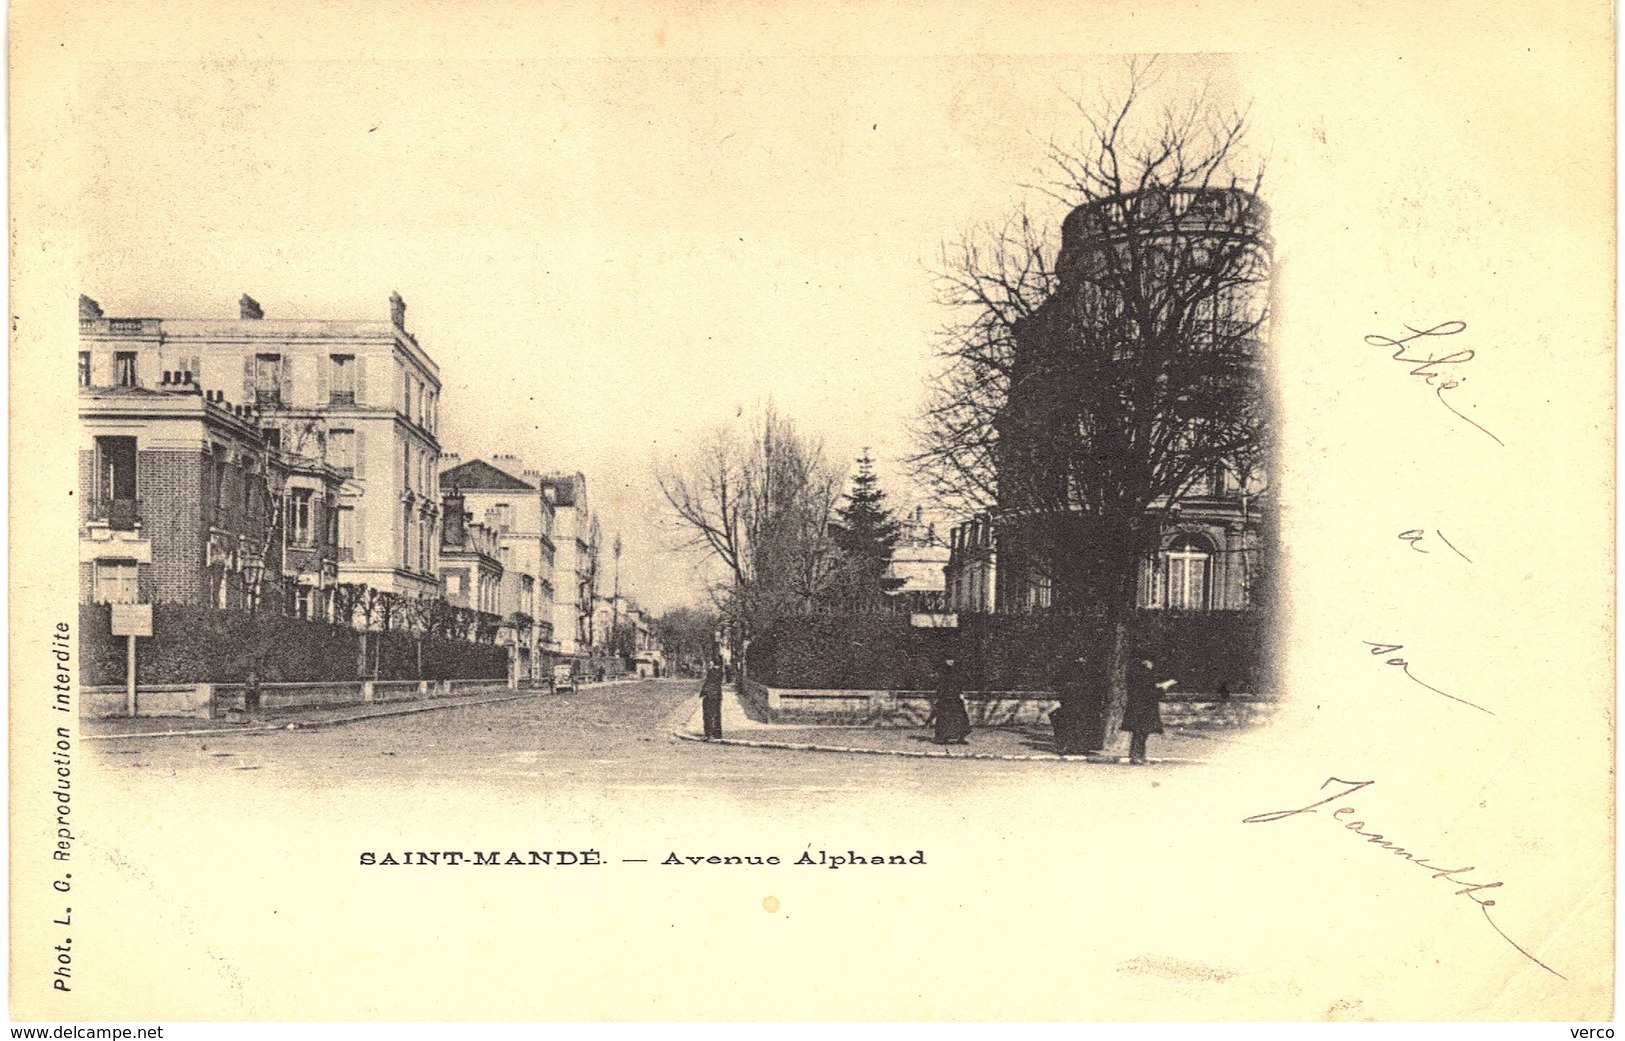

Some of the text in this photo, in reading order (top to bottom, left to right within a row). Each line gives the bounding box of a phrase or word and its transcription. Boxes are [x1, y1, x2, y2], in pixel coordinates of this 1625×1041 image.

[52, 622, 71, 713] interdite
[1362, 640, 1496, 716] sa
[52, 726, 75, 861] Reproduction
[660, 852, 781, 865] Avenue
[53, 907, 72, 925] L.
[53, 938, 72, 992] Phot.
